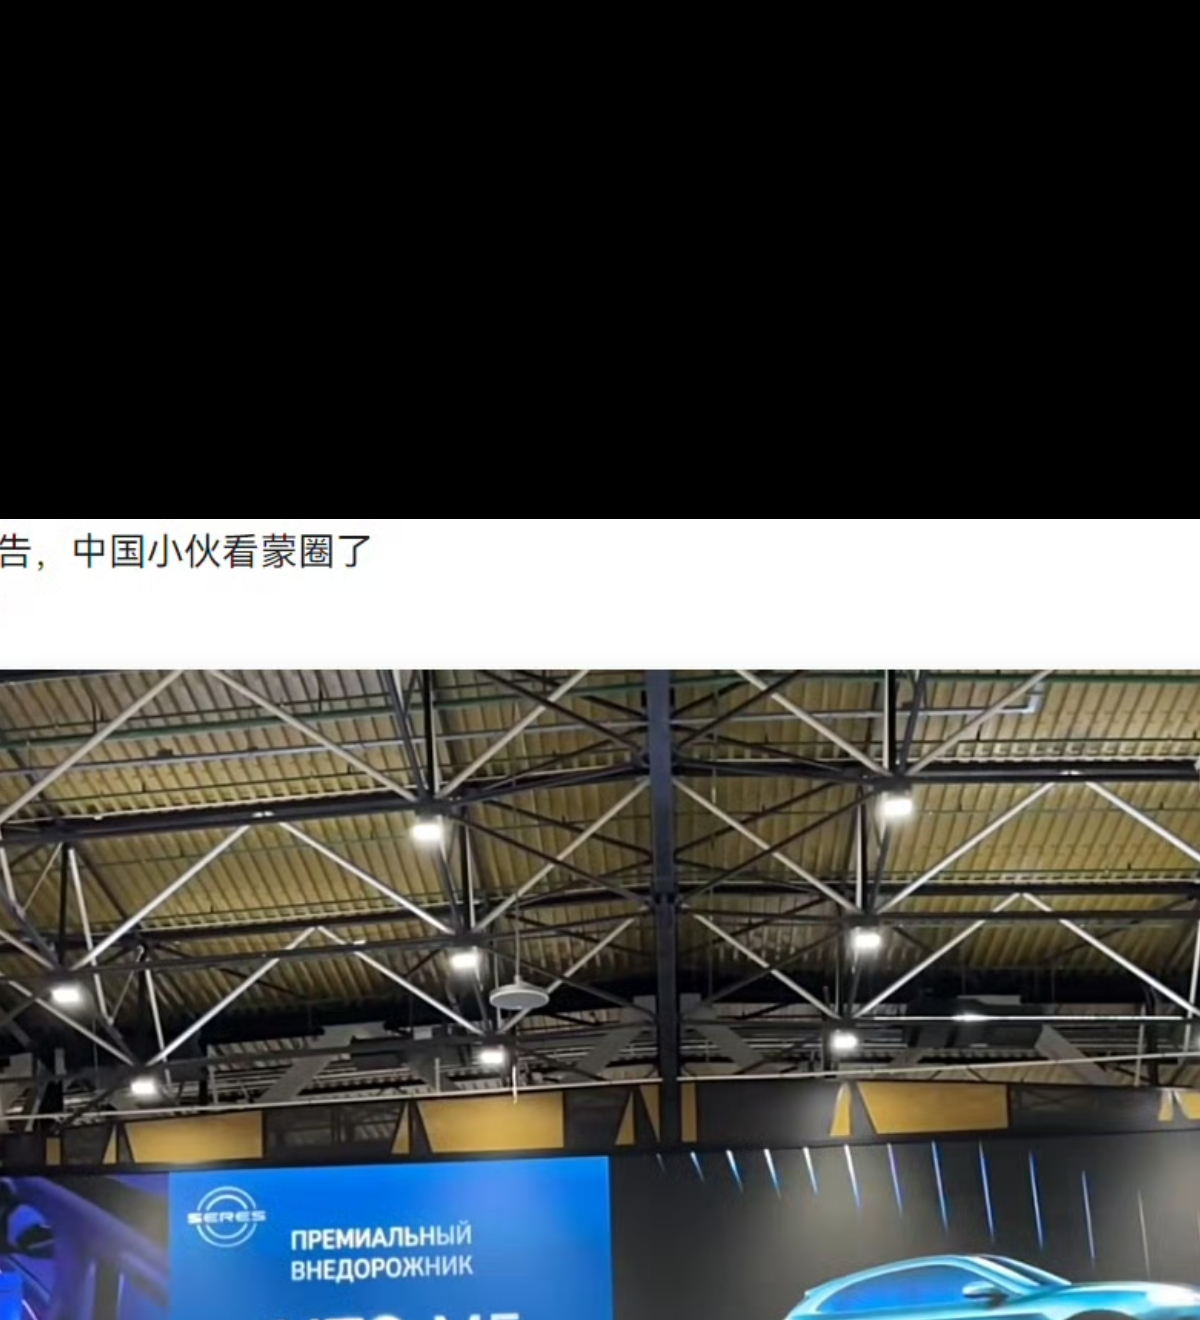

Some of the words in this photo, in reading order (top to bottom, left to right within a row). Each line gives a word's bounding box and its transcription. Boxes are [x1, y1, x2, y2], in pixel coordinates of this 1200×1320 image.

[187, 1210, 266, 1224] SERES
[291, 1220, 472, 1250] ПРЕМИАЛЬНЫЙ
[291, 1255, 474, 1283] ВНЕДОРОЖНИК
